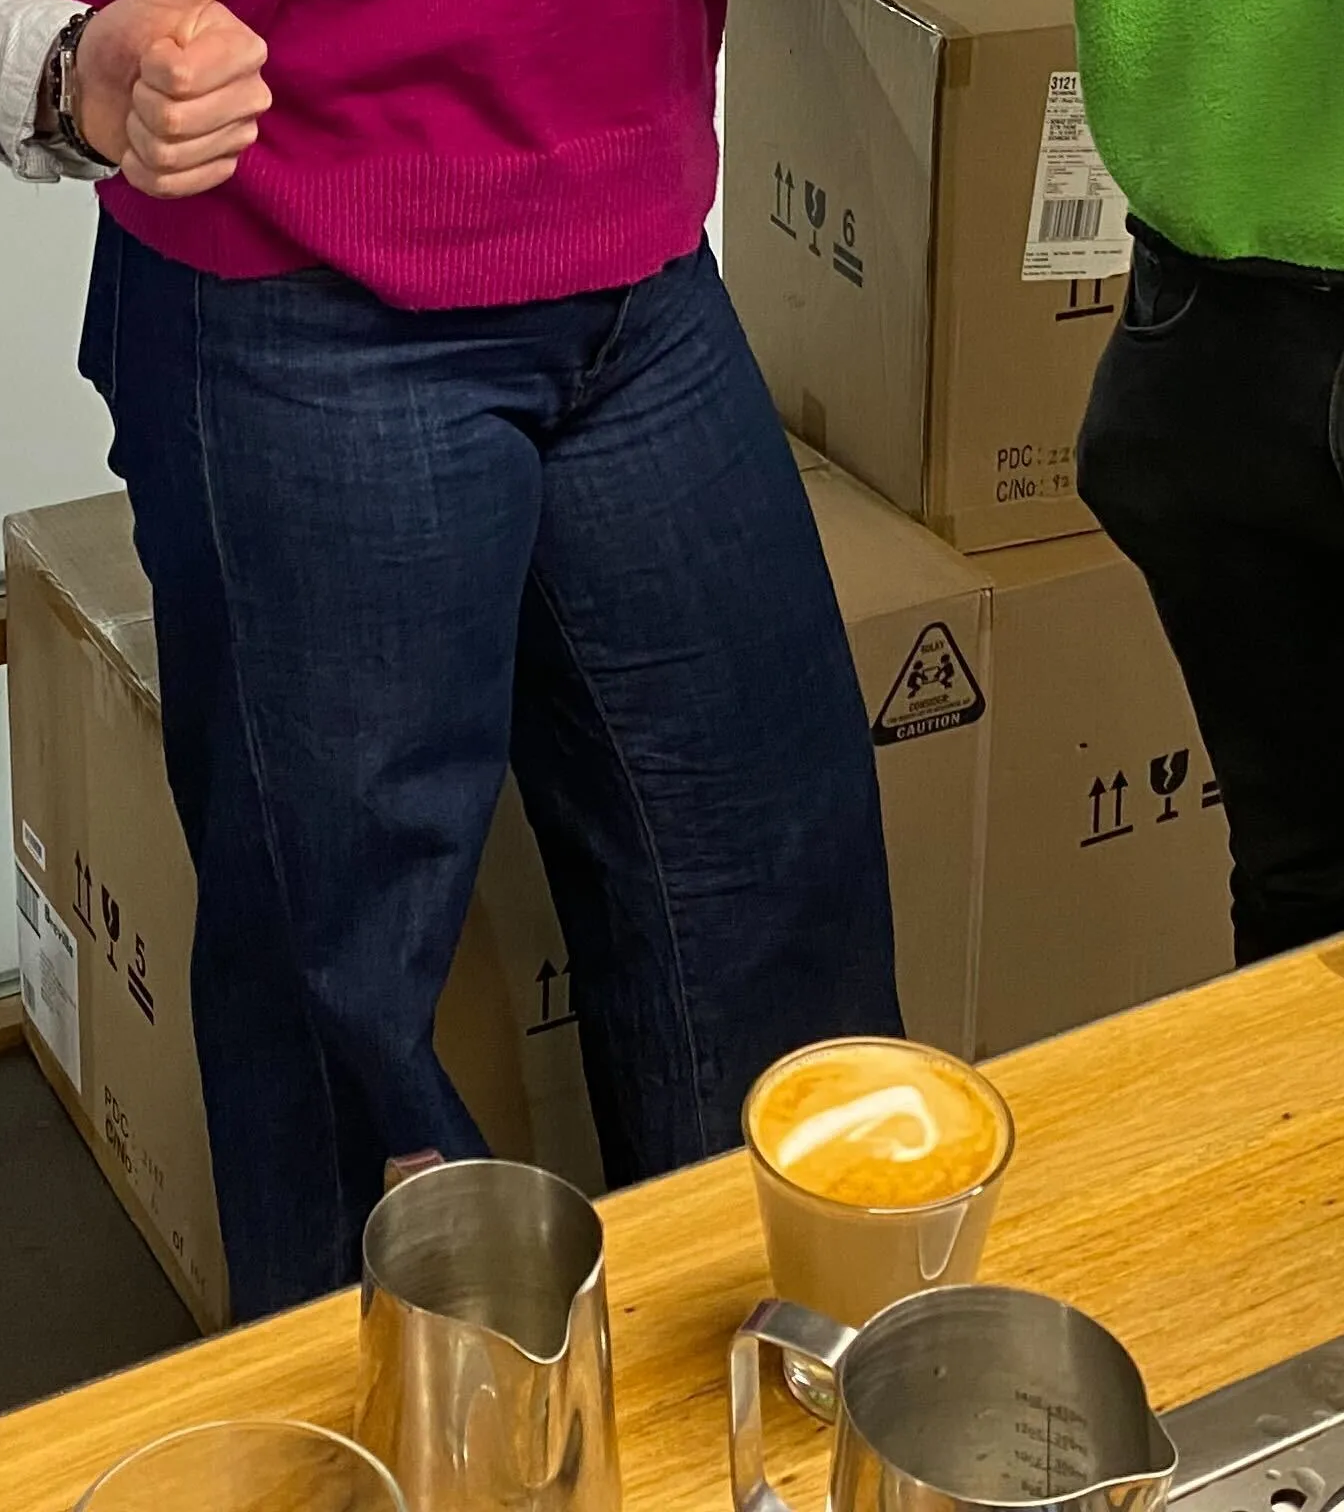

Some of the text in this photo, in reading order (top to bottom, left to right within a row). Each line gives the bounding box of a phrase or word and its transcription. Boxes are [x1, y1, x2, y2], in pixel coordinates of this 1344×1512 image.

[1051, 76, 1076, 90] 3121
[842, 208, 856, 248] 6
[896, 712, 960, 739] CAUTION
[135, 933, 146, 978] 5
